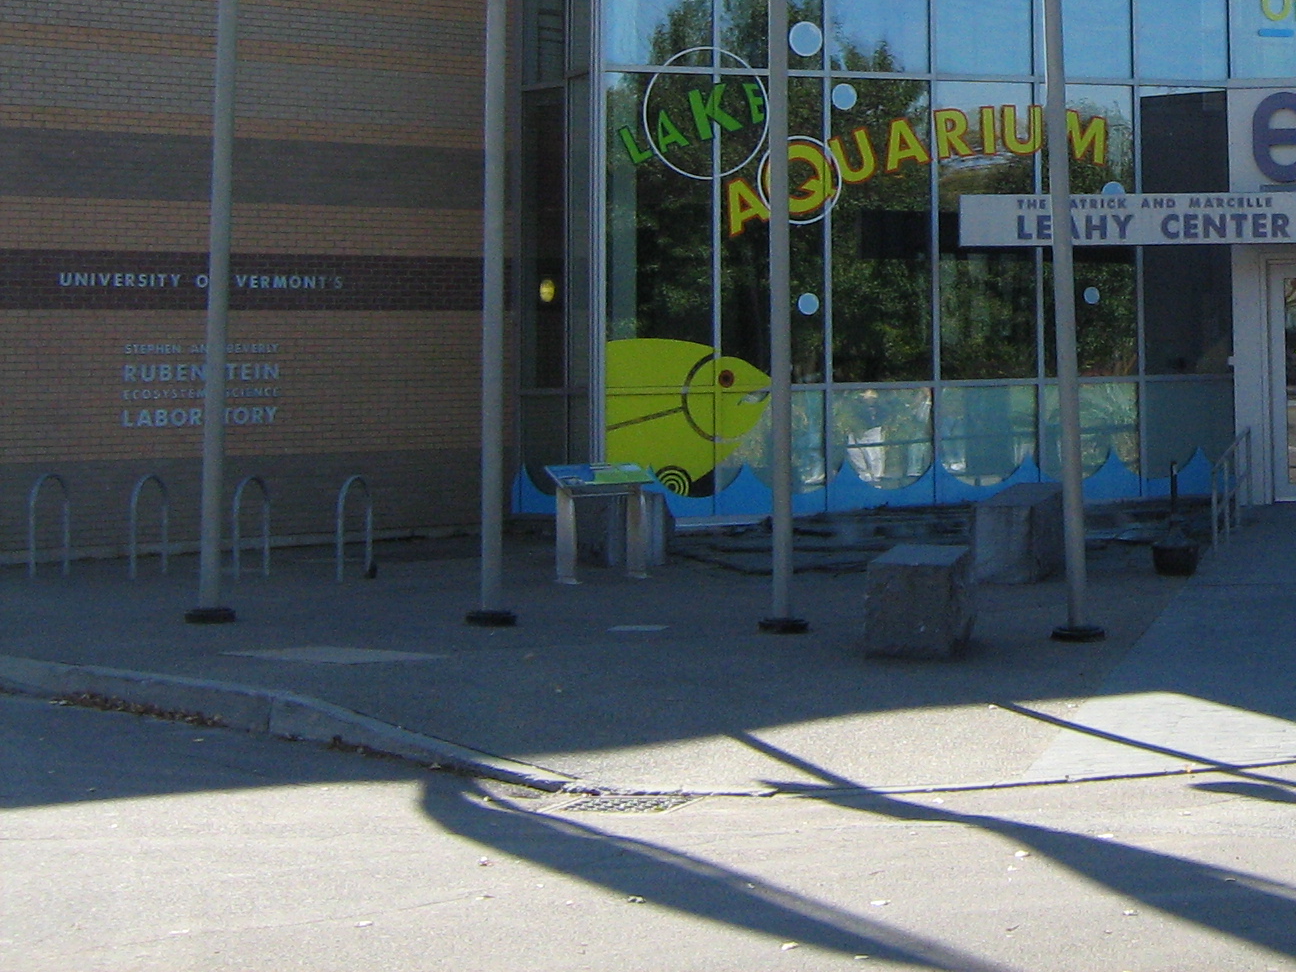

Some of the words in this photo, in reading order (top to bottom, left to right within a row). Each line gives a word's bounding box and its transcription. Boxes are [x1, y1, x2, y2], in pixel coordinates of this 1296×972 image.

[617, 81, 768, 165] LAKE
[725, 103, 1109, 237] AQUARIUM
[1017, 199, 1046, 209] THE
[1069, 198, 1127, 209] ATRICK
[1141, 197, 1176, 208] AND
[1189, 196, 1273, 208] MARCELLE
[1161, 213, 1291, 239] CENTER
[59, 273, 181, 287] UNIVERSITY
[196, 273, 210, 288] O
[235, 275, 344, 289] VERMONT'S
[124, 344, 181, 354] STEPHEN
[189, 344, 208, 354] AN
[122, 363, 280, 382] RUBENTEIN
[121, 406, 278, 427] LABORTORY
